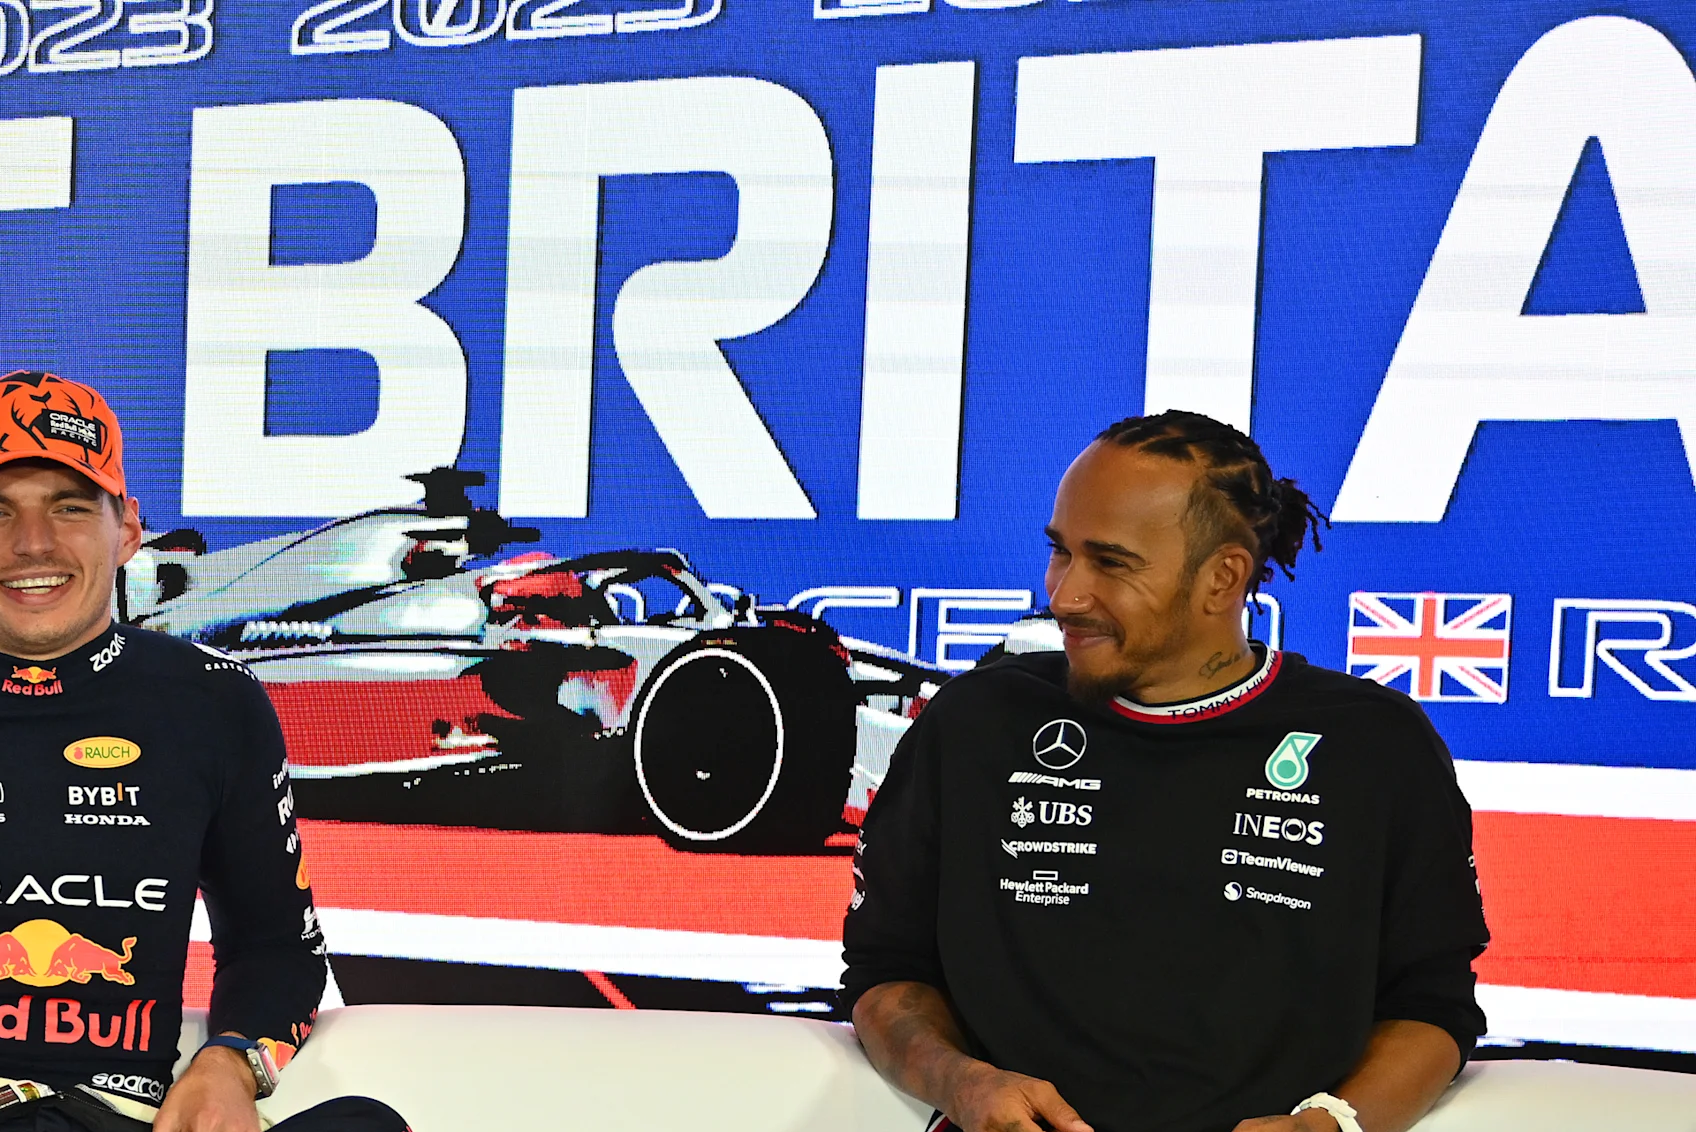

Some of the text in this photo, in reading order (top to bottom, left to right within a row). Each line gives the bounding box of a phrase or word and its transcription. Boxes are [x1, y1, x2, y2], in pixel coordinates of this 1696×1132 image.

[49, 412, 96, 432] ORACLE
[2, 679, 64, 696] Red Bull
[1167, 689, 1244, 720] TOMMY
[85, 746, 130, 759] RAUCH
[1039, 775, 1102, 791] AMG
[68, 782, 140, 806] BYBIT
[1246, 788, 1321, 805] PETRONAS
[63, 813, 152, 827] HONDA
[1038, 801, 1093, 826] UBS
[1233, 812, 1325, 845] INEOS
[1008, 840, 1097, 855] CROWDSTRIKE
[1238, 851, 1324, 878] TeamViewer
[1000, 878, 1089, 895] Hewlett Packard
[1015, 891, 1070, 907] Enterprise
[1246, 887, 1312, 910] Snapdragon
[44, 998, 157, 1052] Bull
[91, 1071, 165, 1102] sparco
